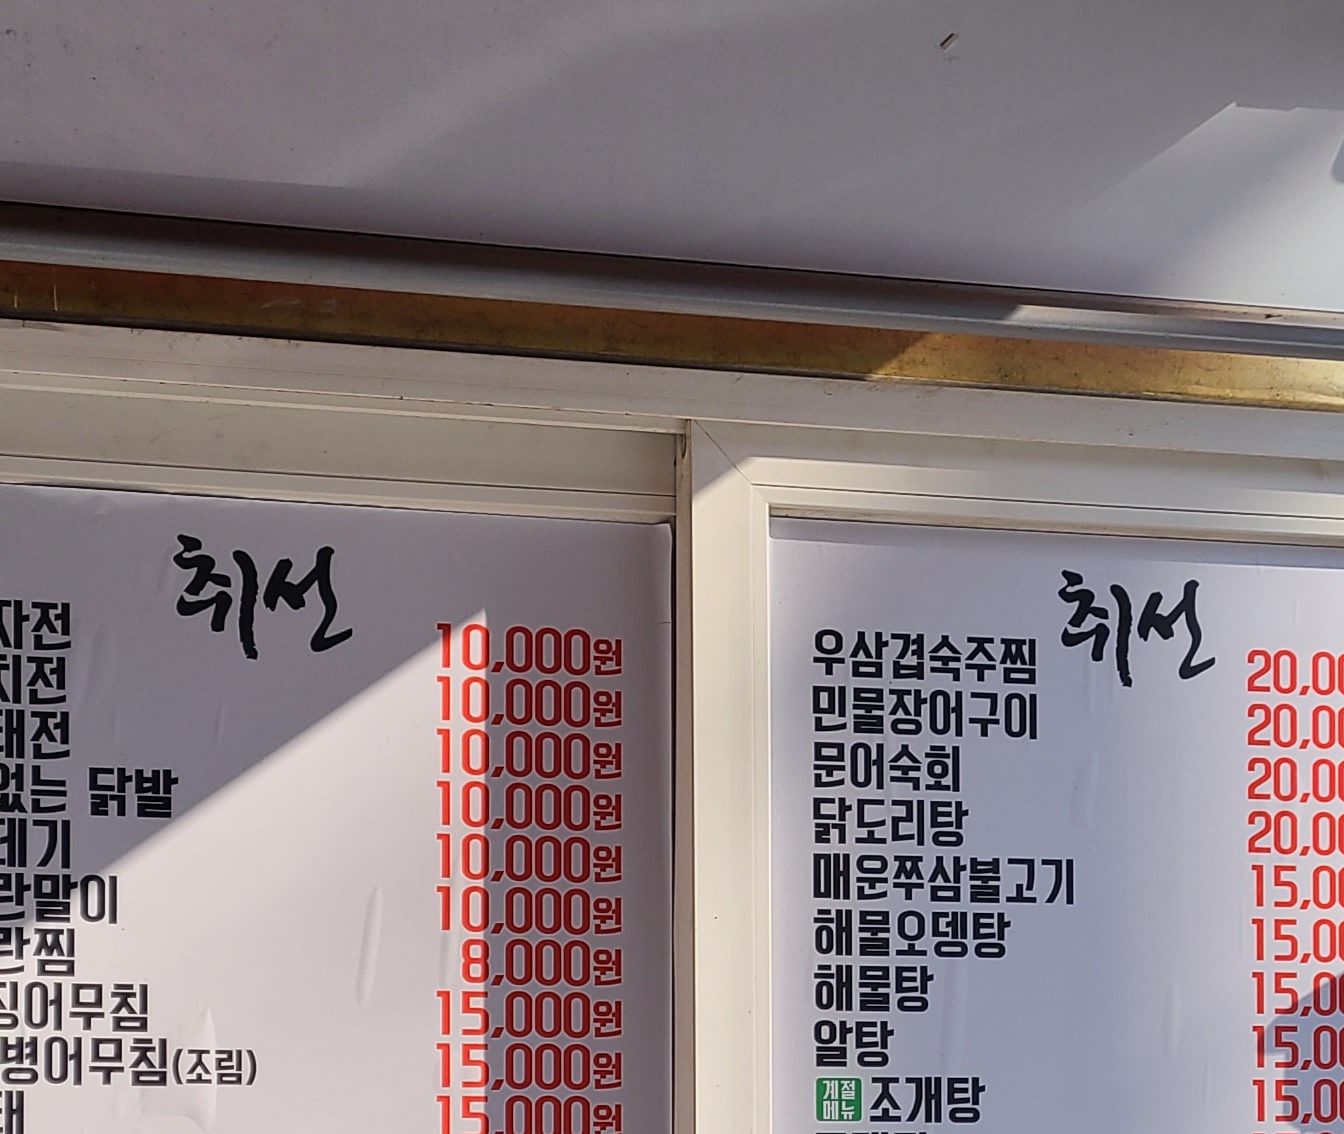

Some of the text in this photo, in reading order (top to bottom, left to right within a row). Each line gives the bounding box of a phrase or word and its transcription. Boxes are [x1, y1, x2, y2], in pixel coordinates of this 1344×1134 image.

[173, 533, 353, 660] 취선
[436, 622, 622, 676] 10,000원
[1057, 568, 1216, 688] 취선
[812, 629, 1037, 685] 우삼겹숙주찜
[435, 674, 622, 729] 10,000원
[812, 685, 1038, 740] 민물장어구이
[435, 727, 622, 781] 10,000원
[813, 741, 960, 793] 문어숙회
[88, 766, 179, 819] 닭발
[435, 779, 622, 832] 10,000원
[812, 797, 969, 848] 닭도리탕
[435, 831, 622, 884] 10,000원
[813, 852, 1074, 905] 매운쭈삼불고기
[435, 884, 623, 936] 10,000원
[813, 908, 1012, 959] 해물오뎅탕
[460, 937, 623, 987] 8,000원
[435, 989, 623, 1039] 15,000원
[813, 964, 934, 1013] 해물탕
[1, 1036, 623, 1091] 병어무침(조림) 15,000원
[813, 1019, 895, 1068] 알탕
[821, 1079, 858, 1100] 계절
[821, 1099, 858, 1121] 메뉴
[869, 1076, 986, 1124] 조개탕
